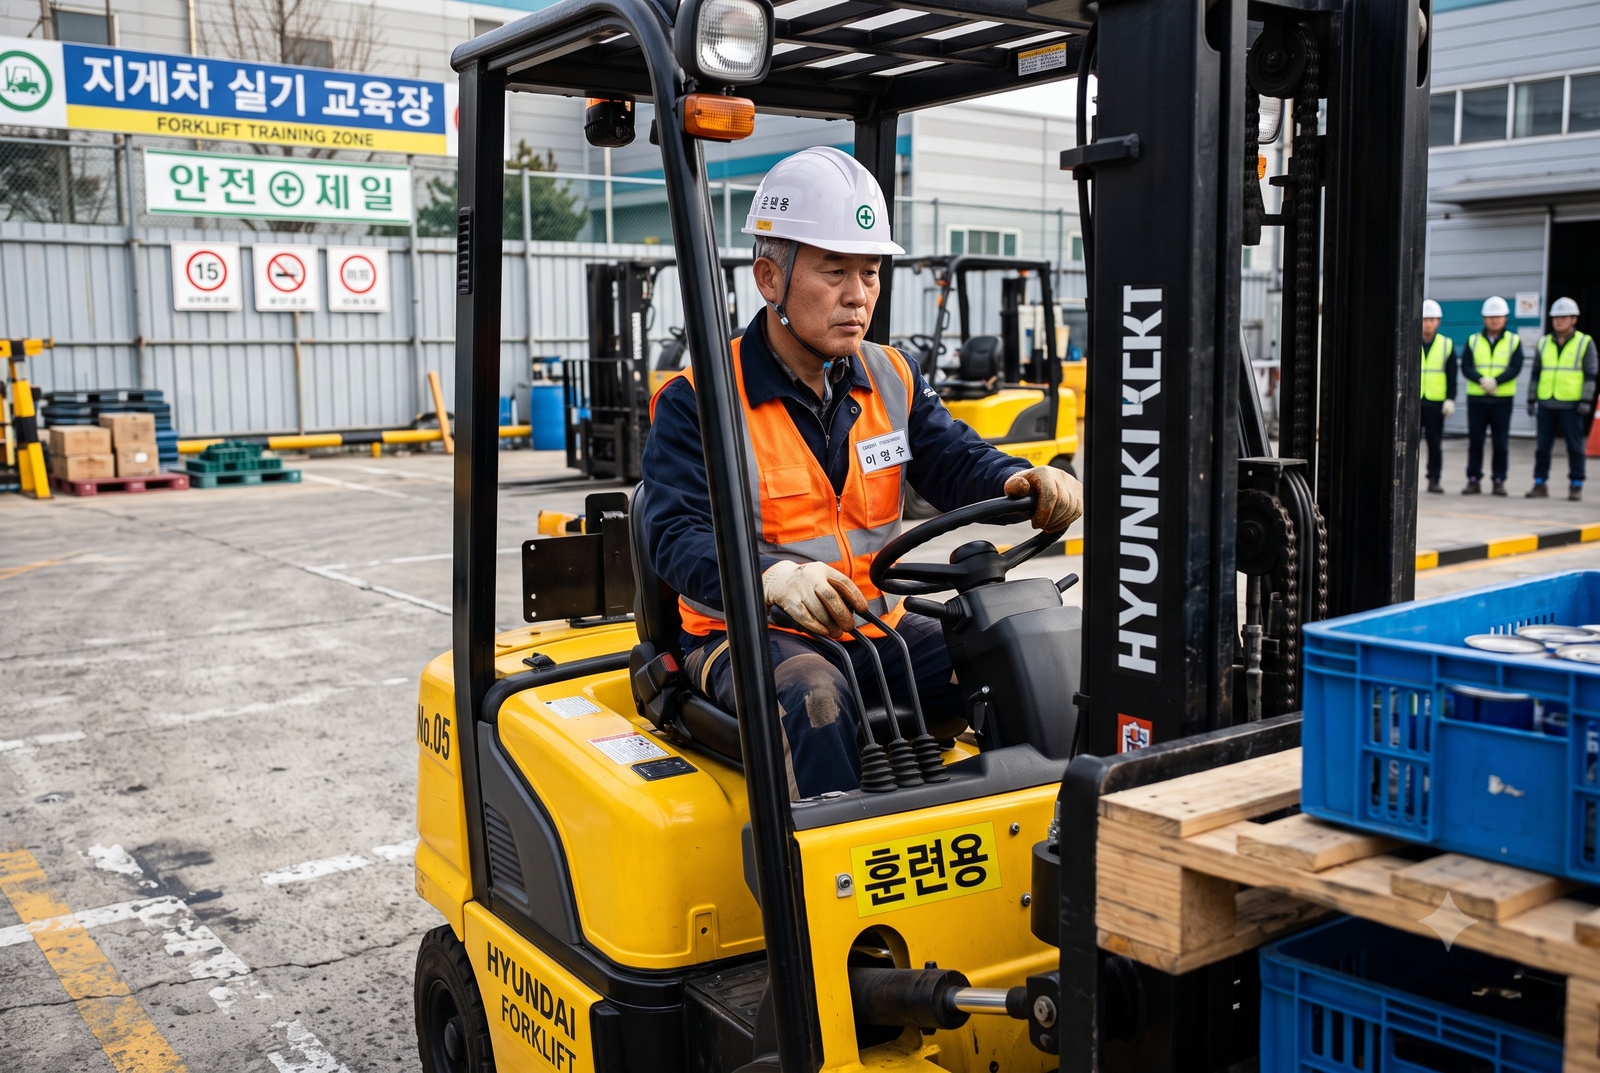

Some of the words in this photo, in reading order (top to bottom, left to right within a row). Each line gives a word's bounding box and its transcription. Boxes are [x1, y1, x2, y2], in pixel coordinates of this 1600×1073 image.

[82, 55, 214, 109] 지게차
[228, 68, 307, 117] 실기
[321, 79, 435, 128] 교육장
[156, 116, 242, 138] FORKLIFT
[248, 124, 327, 145] TRAINING
[331, 130, 375, 148] ZONE
[168, 163, 257, 206] 안전
[315, 173, 394, 212] 제일
[194, 262, 219, 281] 15
[416, 703, 451, 761] No.05
[864, 833, 990, 907] 훈련용
[486, 940, 577, 1042] HYUNDAI
[501, 994, 577, 1073] FORKLIFT
